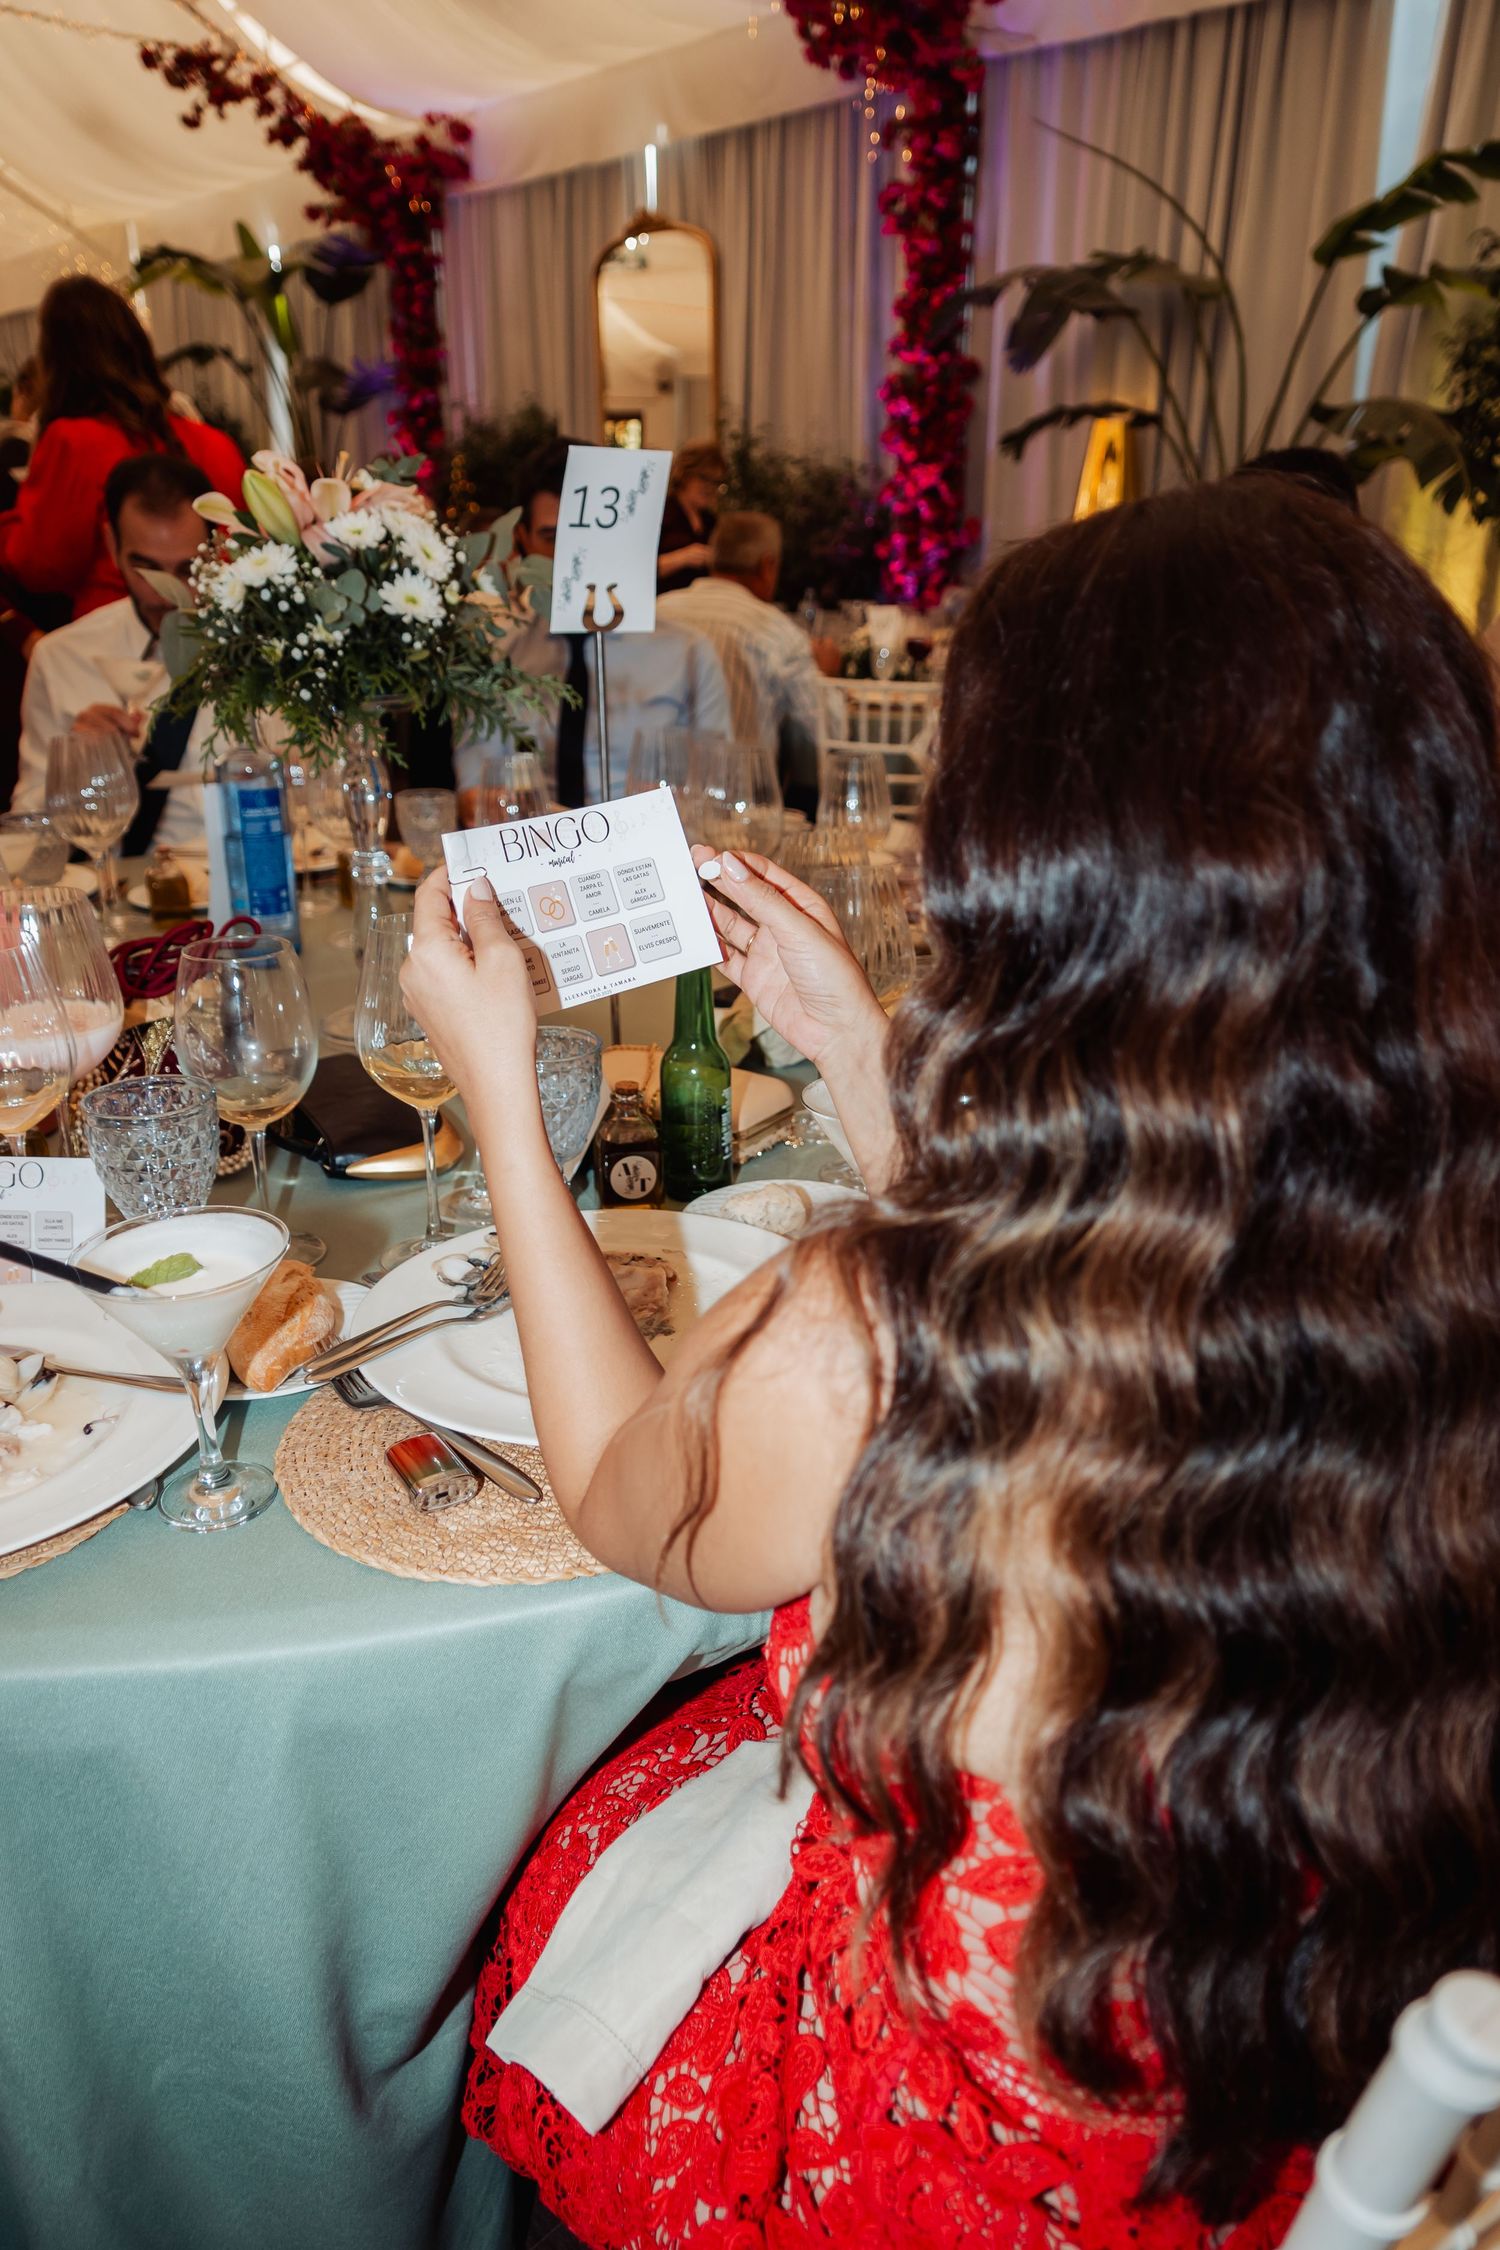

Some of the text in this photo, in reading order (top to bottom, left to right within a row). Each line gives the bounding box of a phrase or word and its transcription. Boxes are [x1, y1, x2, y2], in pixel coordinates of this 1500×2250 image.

[568, 485, 621, 529] 13
[499, 810, 610, 863] BINGO
[548, 850, 575, 867] musical
[577, 873, 601, 883] CUANDO
[633, 872, 650, 880] GATAS
[580, 883, 597, 892] ZARPA
[585, 891, 602, 899] AMOR
[588, 906, 611, 916] CAMELA
[634, 919, 671, 934] SUAVEMENTE
[638, 935, 678, 951] ELVIS CRESPO
[551, 947, 580, 960] VENTANITA
[561, 965, 581, 975] SERGIO
[562, 973, 584, 983] VARGAS
[564, 987, 602, 1001] ALEXANDRA
[610, 976, 637, 988] TAMARA
